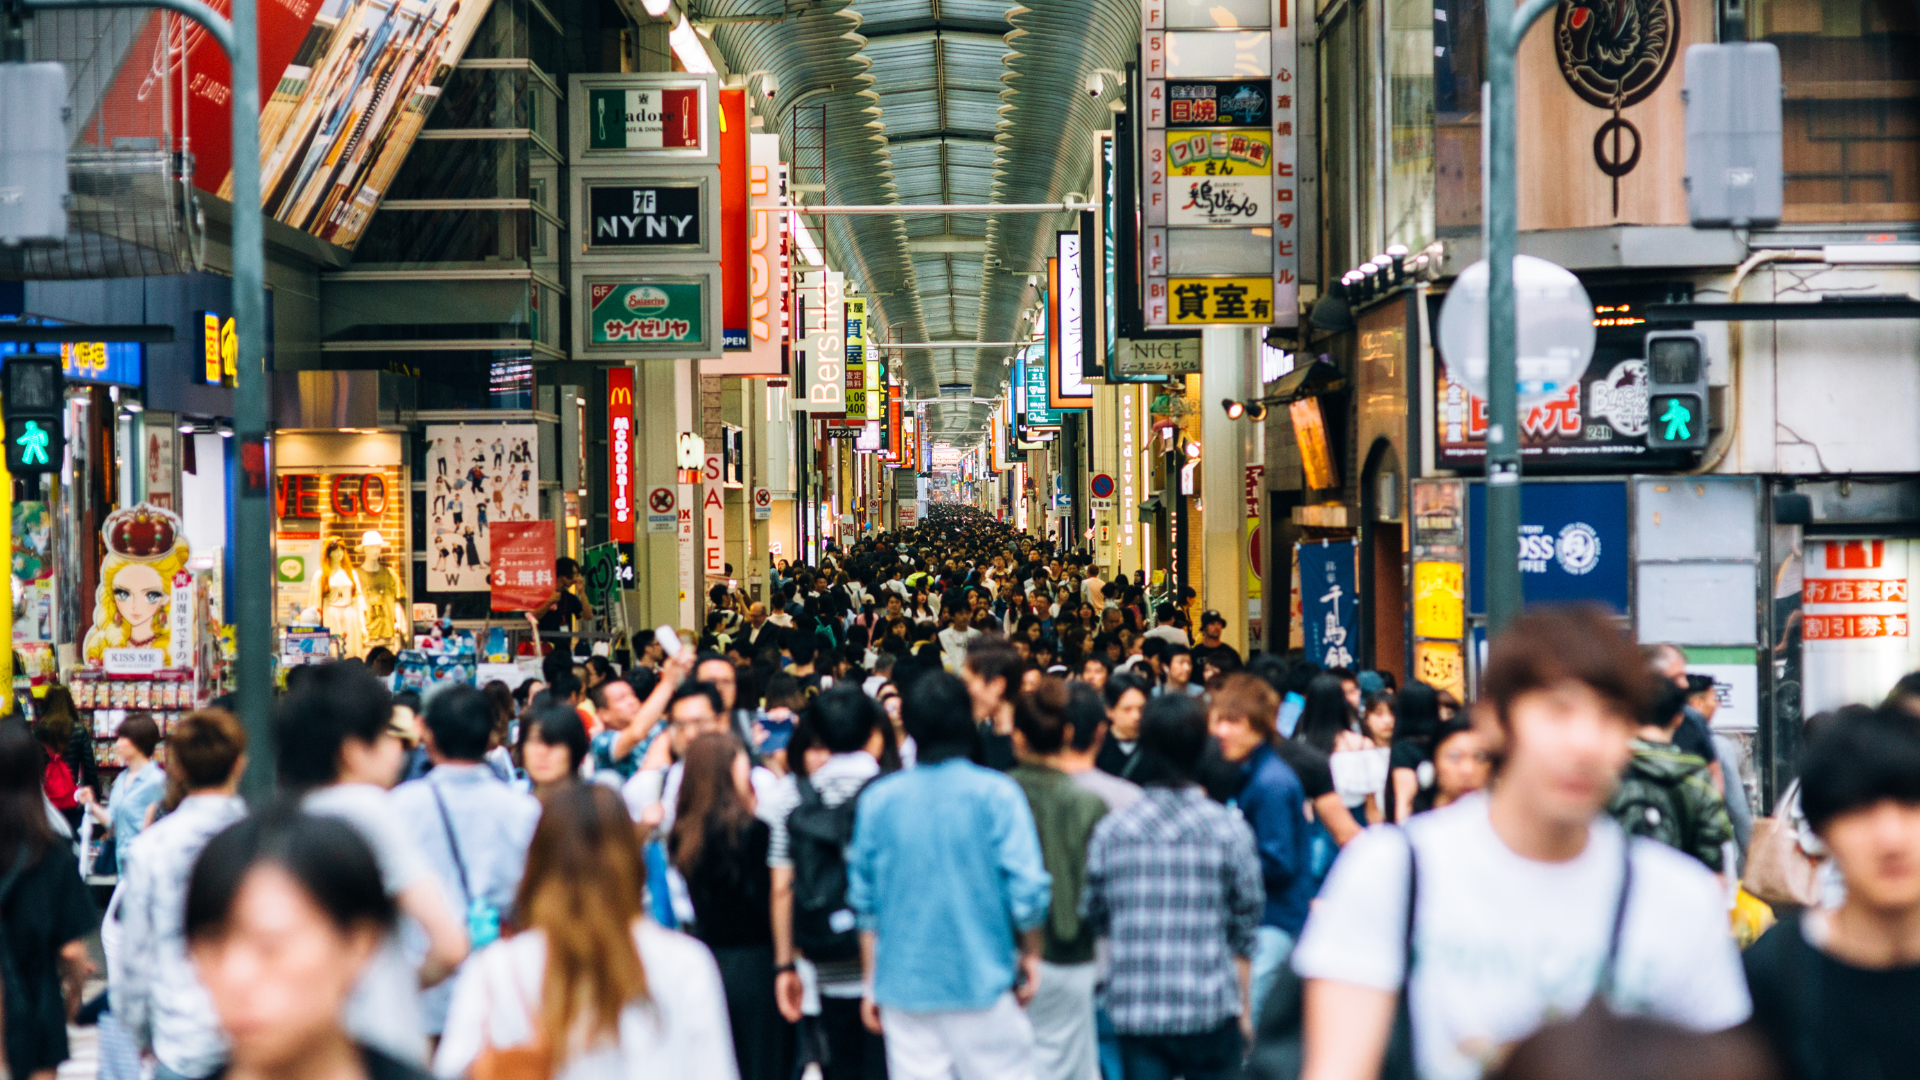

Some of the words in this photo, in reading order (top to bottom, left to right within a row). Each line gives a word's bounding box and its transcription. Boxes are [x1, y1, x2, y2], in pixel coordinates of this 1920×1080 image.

[612, 108, 675, 124] J'adore
[1171, 99, 1217, 122] 日焼
[1173, 136, 1266, 161] フリー麻雀
[1181, 165, 1196, 176] 3F
[1205, 160, 1234, 176] さん
[634, 192, 656, 213] 7F
[597, 214, 694, 238] NYNY
[593, 285, 609, 297] 6F
[604, 317, 690, 341] サイゼリヤ
[810, 280, 841, 404] Bershka
[1134, 342, 1183, 359] NICE
[854, 392, 865, 403] 06
[613, 416, 630, 523] McDonald's
[1123, 393, 1134, 547] stradivarius
[704, 457, 723, 570] SALE
[1806, 581, 1907, 601] お店案内
[111, 653, 135, 663] KISS
[138, 653, 156, 663] ME
